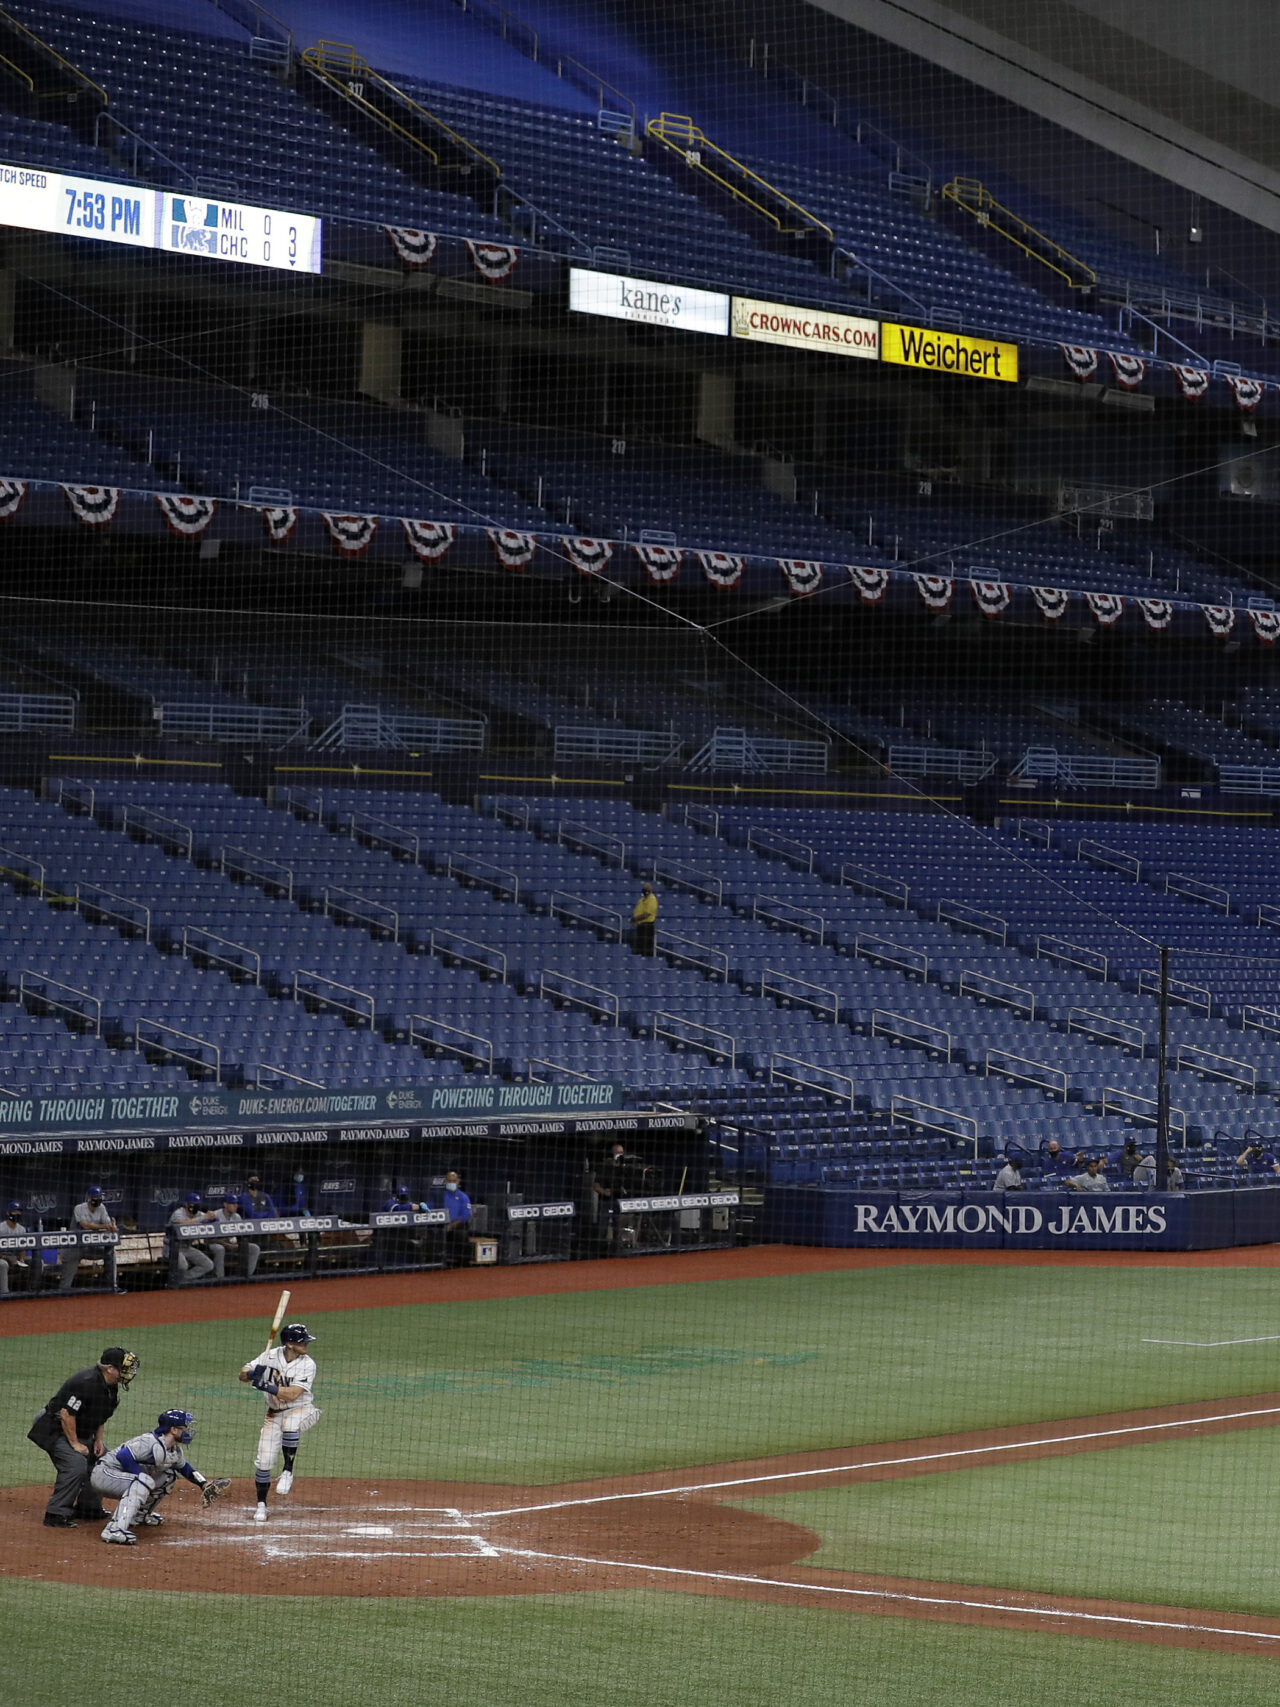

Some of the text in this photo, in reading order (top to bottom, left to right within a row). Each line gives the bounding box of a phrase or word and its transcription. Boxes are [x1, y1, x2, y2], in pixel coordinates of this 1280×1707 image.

[19, 171, 47, 189] SPEED
[65, 188, 140, 236] 7:53 PM
[222, 207, 272, 235] MIL 0
[220, 234, 271, 261] CHC 0
[288, 226, 297, 258] 3
[620, 280, 682, 316] kane's
[750, 312, 877, 348] CROWNCARS.COM
[900, 328, 1000, 377] Weichert
[202, 1096, 220, 1105] DUKE
[399, 1090, 415, 1100] DUKE
[432, 1084, 614, 1109] POWERING THROUGH TOGETHER
[40, 1098, 105, 1121] THROUGH
[111, 1096, 179, 1119] TOGETHER
[238, 1095, 377, 1115] DUKE-ENERGY.COM/TOGETHER
[500, 1122, 564, 1135] RAYMOND JAMES
[575, 1119, 638, 1131] RAYMOND JAMES
[648, 1117, 684, 1128] RAYMOND
[256, 1131, 328, 1144] RAYMOND JAMES
[340, 1128, 410, 1140] RAYMOND JAMES
[421, 1125, 488, 1138] RAYMOND JAMES
[0, 1141, 63, 1154] MOND JAMES
[77, 1138, 155, 1151] RAYMOND JAMES
[168, 1135, 243, 1148] RAYMOND JAMES
[621, 1194, 739, 1210] GEICO GEICO GEICO GEICO
[376, 1215, 408, 1225] GEICO
[413, 1212, 446, 1223] GEICO
[510, 1205, 574, 1218] GEICO GEICO
[854, 1205, 1167, 1234] RAYMOND JAMES
[180, 1224, 215, 1236] GEICO
[220, 1222, 255, 1234] GEICO
[260, 1220, 294, 1231] GEICO
[299, 1218, 332, 1229] GEICO
[0, 1232, 118, 1248] GEICO GEICO GEICO
